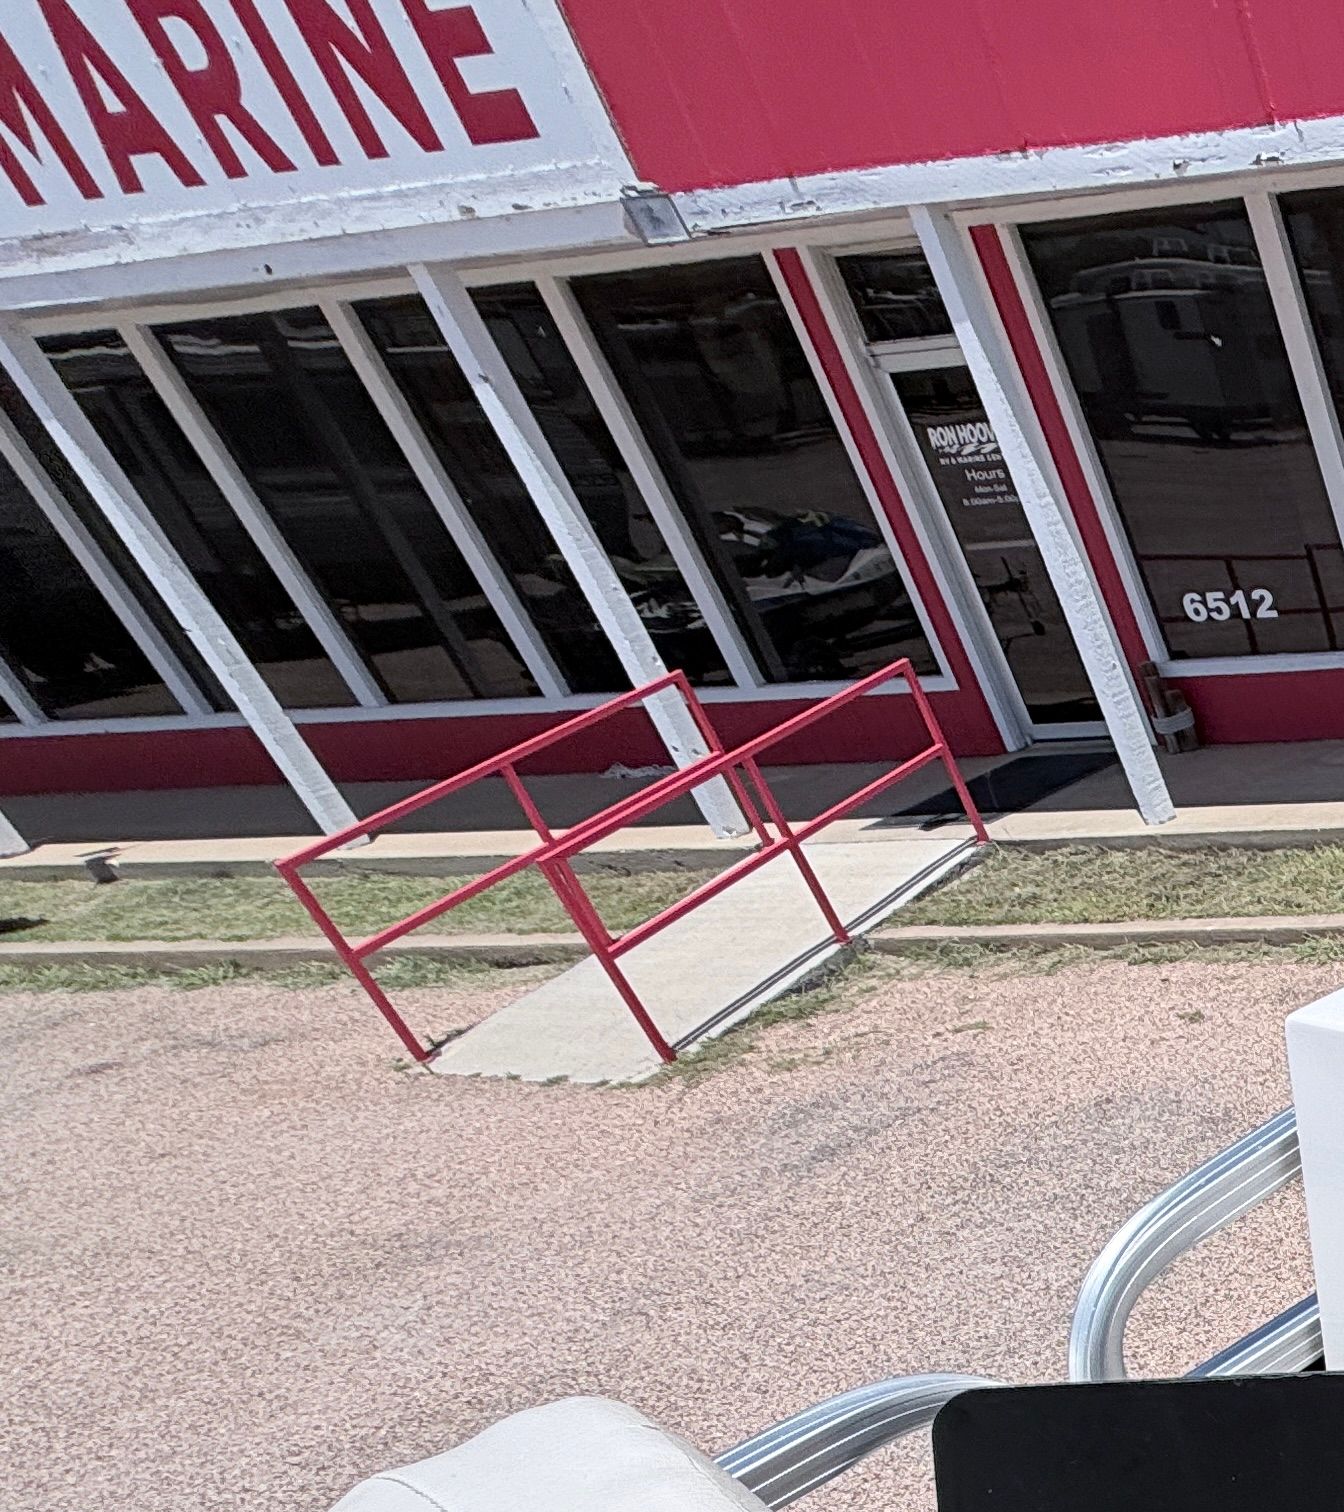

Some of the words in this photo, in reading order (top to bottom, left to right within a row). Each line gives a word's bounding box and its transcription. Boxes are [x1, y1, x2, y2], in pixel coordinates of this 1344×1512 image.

[0, 0, 540, 206] MARINE
[926, 425, 959, 450] RON
[955, 422, 995, 444] HOOV
[964, 468, 1006, 481] Hours
[1182, 588, 1279, 622] 6512
